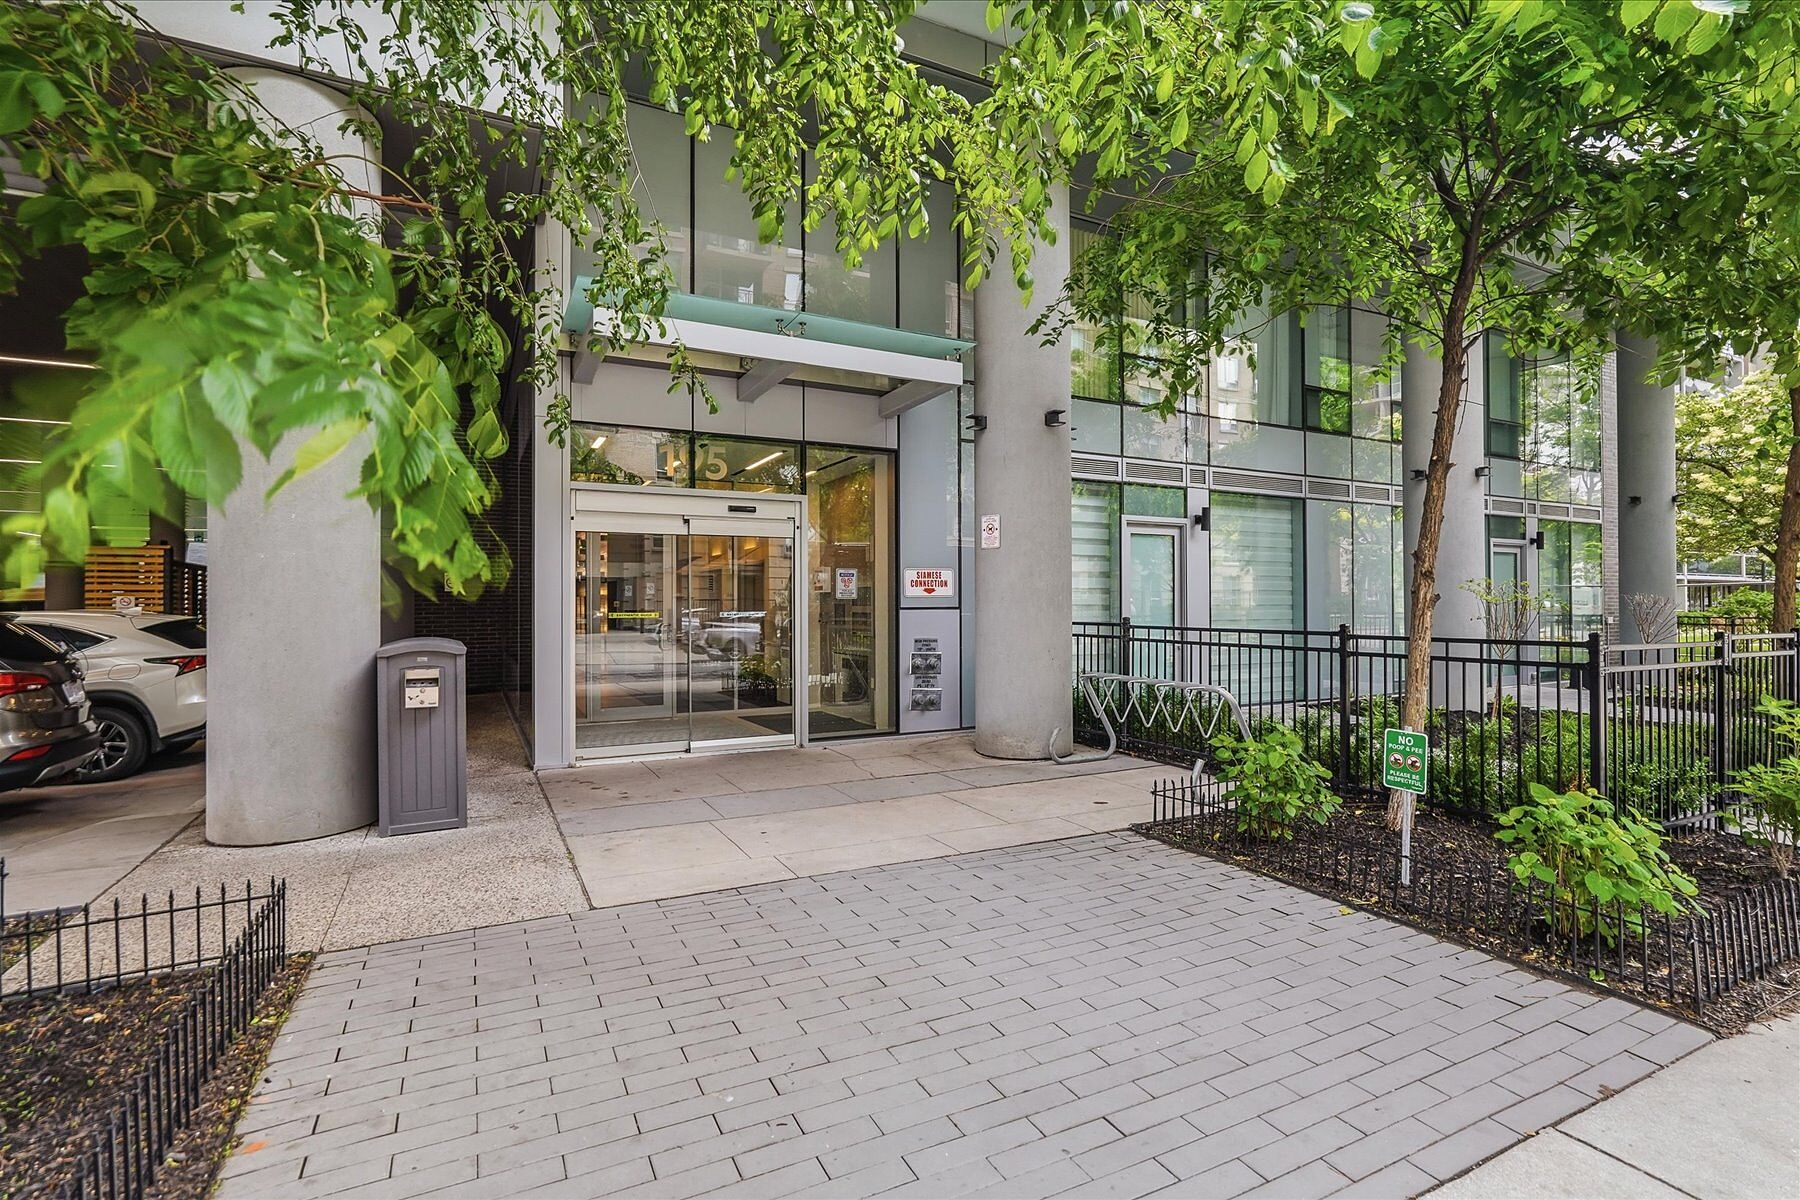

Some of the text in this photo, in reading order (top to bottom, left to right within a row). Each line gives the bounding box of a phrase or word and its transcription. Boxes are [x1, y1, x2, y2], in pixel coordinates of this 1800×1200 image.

[659, 445, 728, 480] 195
[916, 571, 942, 579] SIAMESE
[910, 579, 948, 588] CONNECTION
[1398, 735, 1414, 746] NO
[1388, 743, 1405, 751] POOP
[1411, 747, 1424, 755] PEE
[1390, 770, 1411, 779] PLEASE
[1387, 774, 1422, 787] RESPECTFUL
